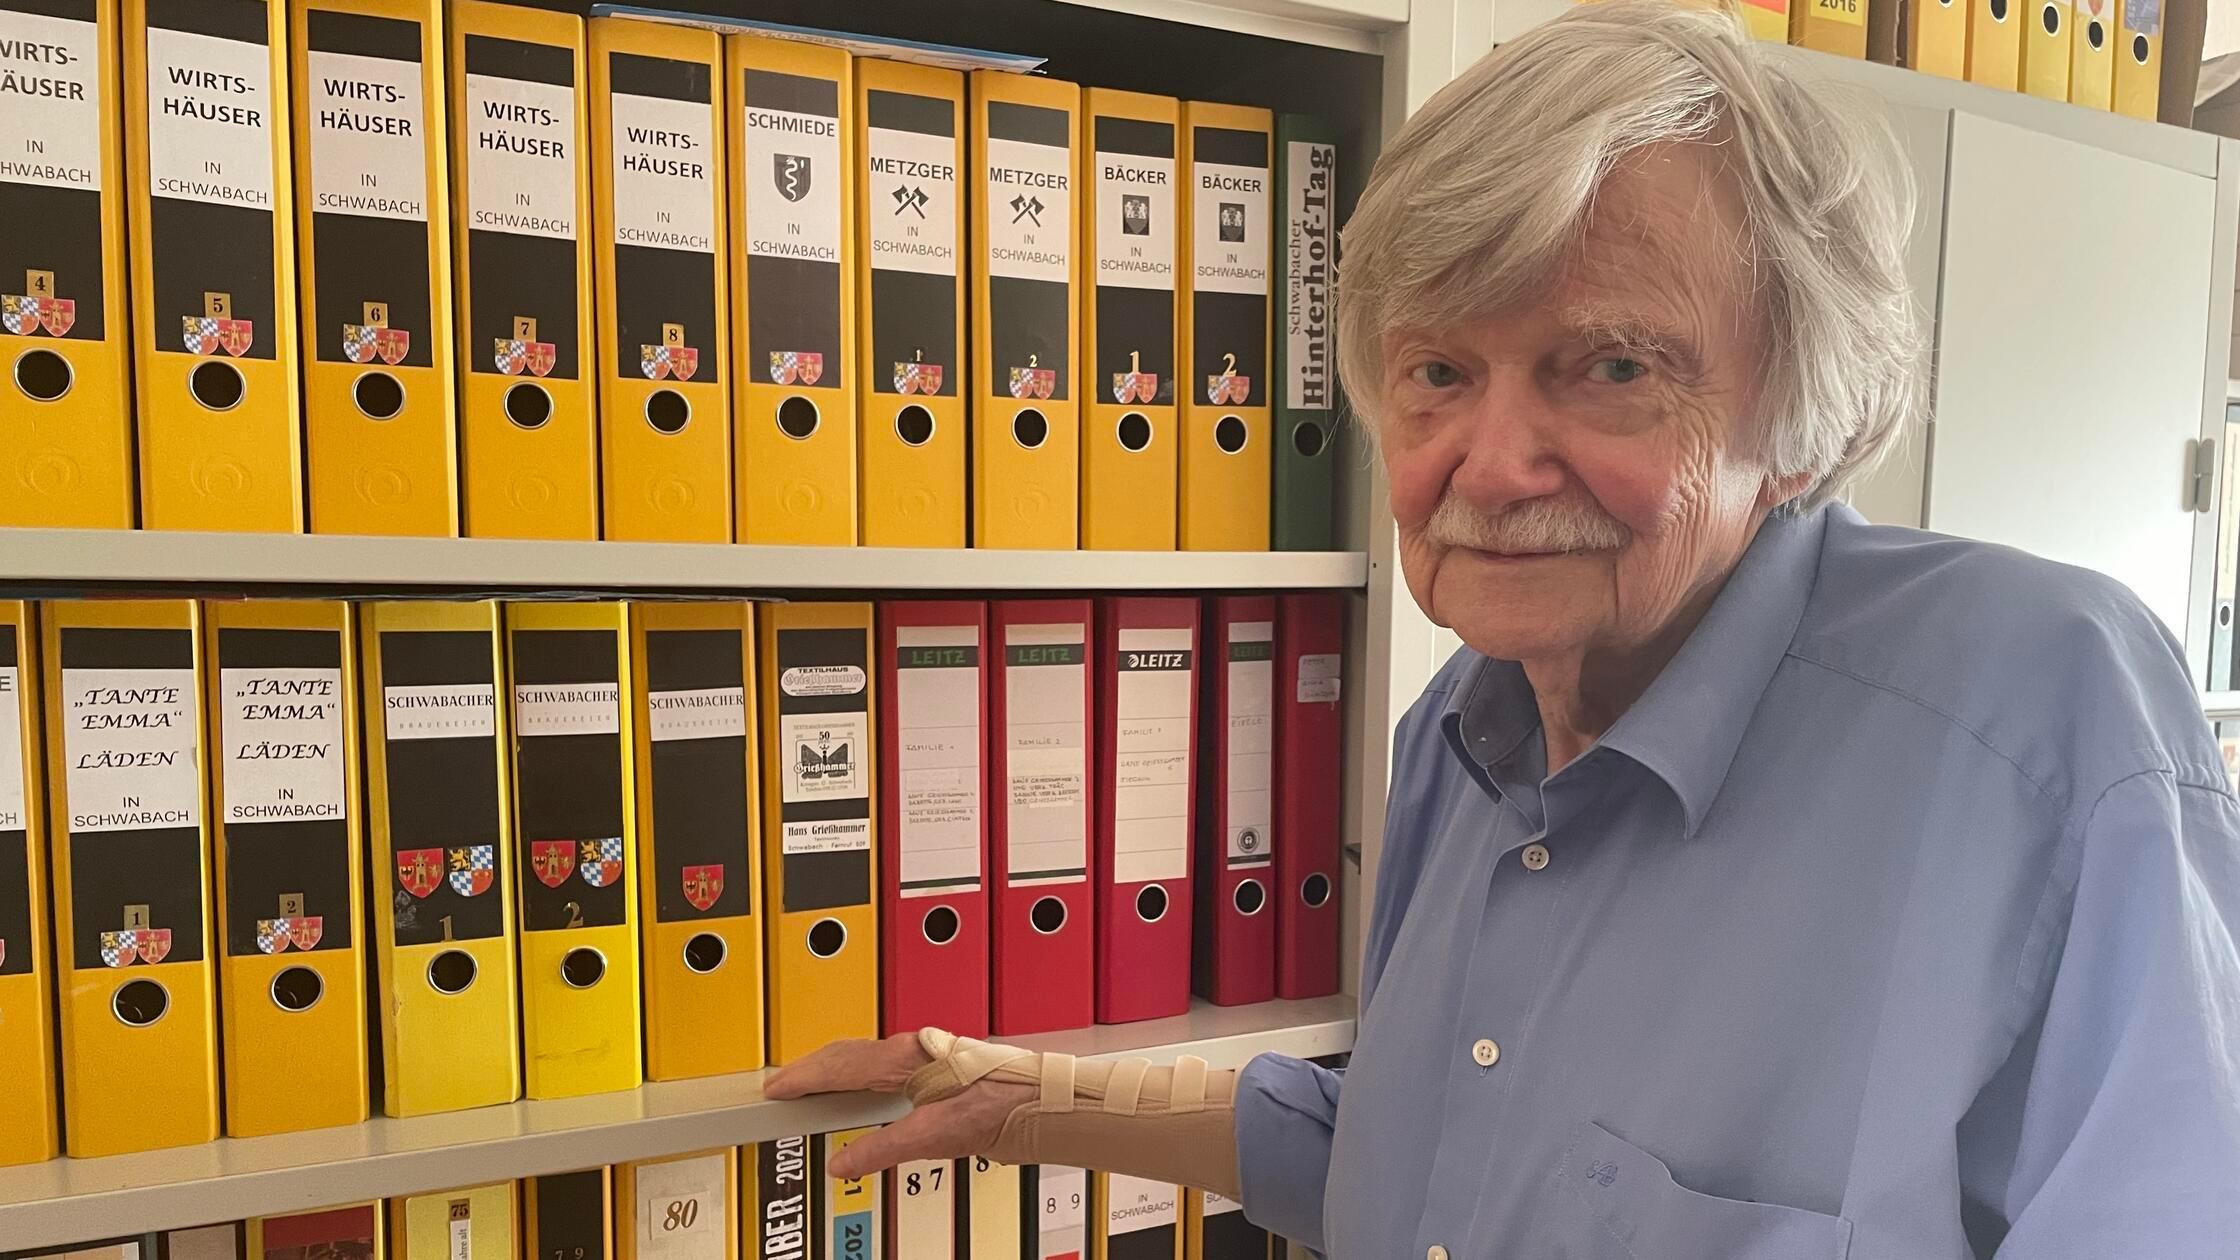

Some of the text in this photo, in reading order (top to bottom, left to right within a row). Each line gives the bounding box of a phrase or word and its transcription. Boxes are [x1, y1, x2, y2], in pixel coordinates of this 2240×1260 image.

[0, 69, 85, 101] ÄUSER
[168, 66, 256, 94] WIRTS-
[324, 78, 406, 103] WIRTS-
[163, 96, 262, 128] HÄUSER
[483, 100, 560, 126] WIRTS-
[320, 109, 412, 137] HÄUSER
[748, 112, 836, 138] SCHMIEDE
[26, 139, 44, 154] IN
[479, 130, 565, 160] HÄUSER
[627, 126, 698, 150] WIRTS-
[0, 161, 92, 183] HWABACH
[204, 160, 222, 176] IN
[623, 154, 704, 180] HÄUSER
[870, 157, 954, 182] METZGER
[1104, 164, 1166, 185] BÄCKER
[361, 173, 377, 188] IN
[989, 167, 1068, 190] METZGER
[1202, 174, 1262, 193] BÄCKER
[158, 177, 268, 204] SCHWABACH
[318, 192, 421, 216] SCHWABACH
[515, 193, 530, 206] IN
[475, 210, 570, 234] SCHWABACH
[656, 212, 670, 224] IN
[788, 222, 800, 235] IN
[906, 226, 918, 237] IN
[619, 227, 709, 249] SCHWABACH
[1024, 234, 1034, 245] IN
[752, 240, 835, 260] SCHWABACH
[873, 240, 952, 259] SCHWABACH
[992, 248, 1066, 266] SCHWABACH
[1130, 247, 1142, 258] IN
[1100, 259, 1172, 274] SCHWABACH
[1226, 253, 1238, 264] IN
[1197, 266, 1266, 280] SCHWABACH
[1288, 219, 1301, 335] Schwabacher
[1301, 145, 1333, 407] Hinterhof-Tag
[34, 276, 47, 291] 4
[212, 297, 224, 314] 5
[370, 307, 381, 322] 6
[520, 322, 529, 335] 7
[668, 328, 678, 342] 8
[915, 350, 923, 362] 1
[1029, 354, 1038, 367] 2
[1129, 350, 1140, 374] 1
[1222, 352, 1238, 376] 2
[912, 650, 966, 666] LEITZ
[1018, 647, 1071, 663] LEITZ
[1140, 654, 1184, 668] LEITZ
[798, 666, 848, 674] TEXTILHAUS
[388, 694, 494, 710] SCHWABACHER
[517, 690, 618, 704] SCHWABACHER
[650, 694, 744, 710] SCHWABACHER
[819, 730, 830, 740] 50
[236, 741, 330, 760] LÄDEN
[76, 750, 178, 770] LÄDEN
[122, 796, 140, 808] IN
[278, 788, 294, 800] IN
[74, 810, 189, 828] SCHWABACH
[232, 804, 338, 818] SCHWABACH
[788, 826, 808, 837] Hans
[286, 900, 297, 914] 2
[562, 902, 584, 929] 2
[133, 912, 140, 926] 1
[440, 916, 453, 942] 1
[765, 1135, 804, 1260] BER 2020
[1138, 1193, 1148, 1204] IN
[451, 1203, 469, 1218] 75
[662, 1198, 698, 1232] 80
[1110, 1200, 1175, 1221] SCHWABACH
[459, 1240, 468, 1260] ahre
